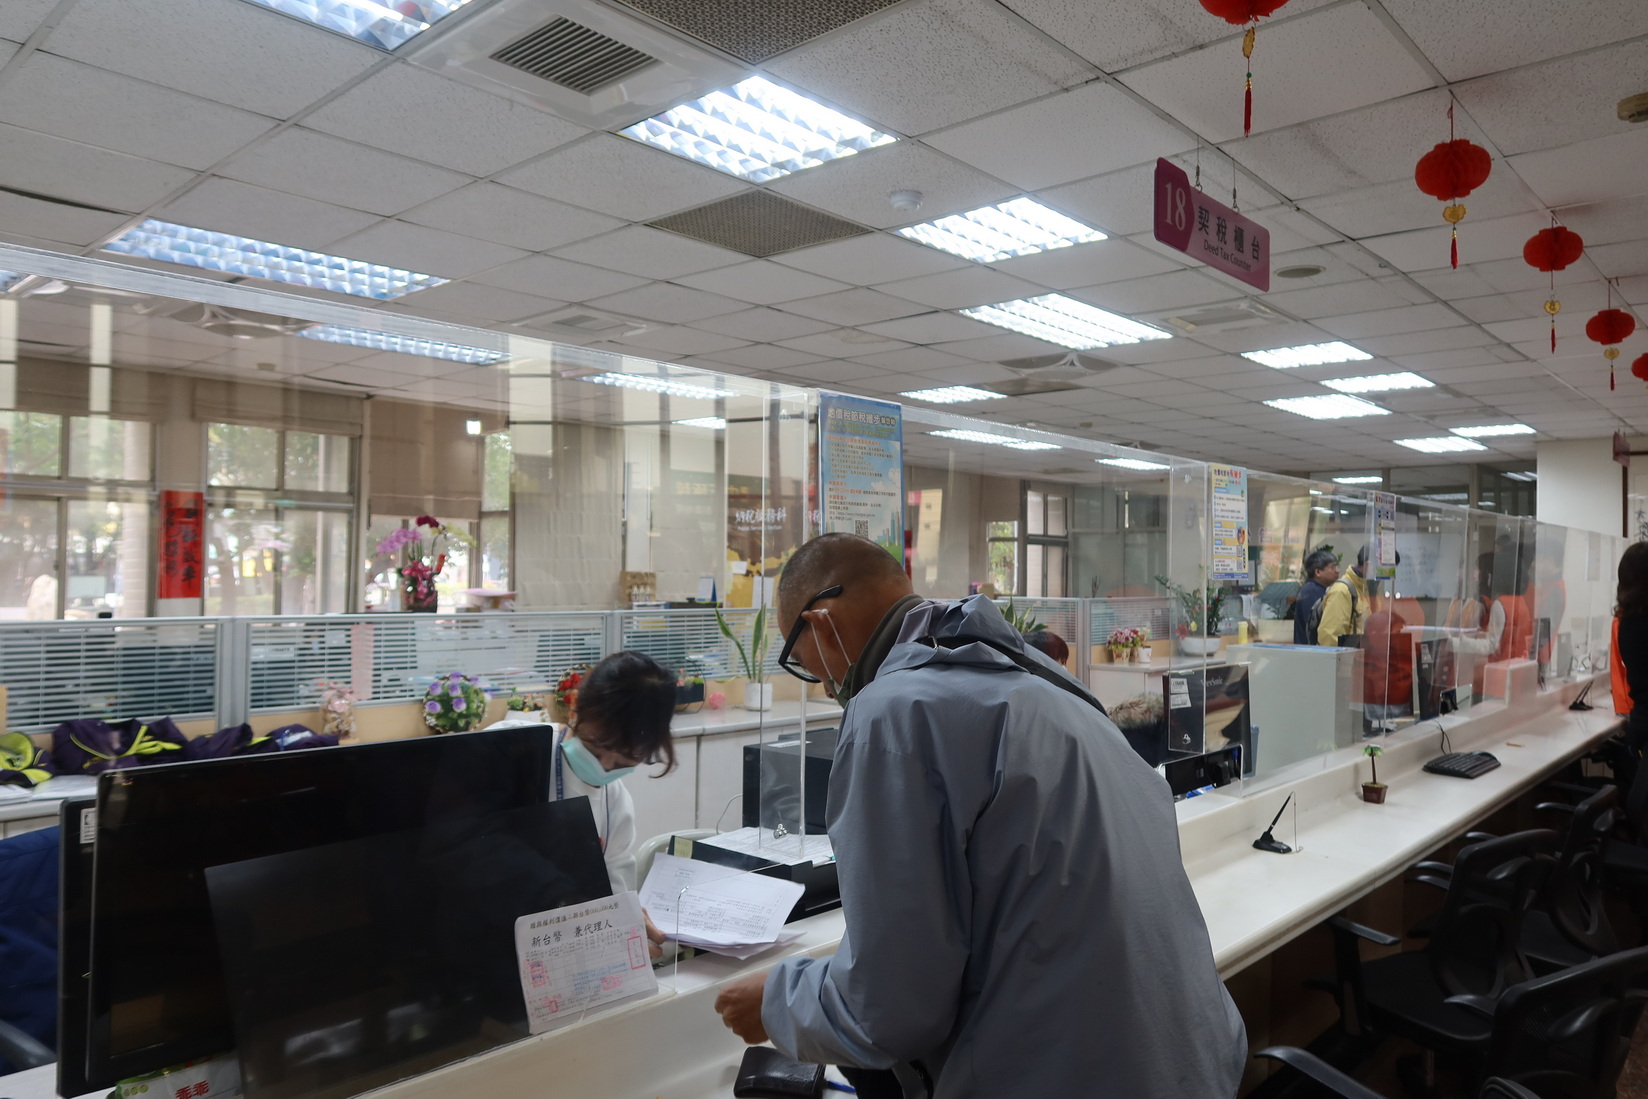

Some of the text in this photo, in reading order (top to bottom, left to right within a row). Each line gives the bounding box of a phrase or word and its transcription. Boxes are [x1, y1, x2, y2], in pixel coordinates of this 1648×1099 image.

[1164, 182, 1186, 231] 18
[1198, 206, 1260, 262] 契稅櫃台
[1203, 239, 1251, 272] Deed Tax Counter
[1200, 676, 1223, 687] VewSonic
[531, 919, 613, 948] 新台幣 兼代理人
[175, 1080, 210, 1099] 乖乖
